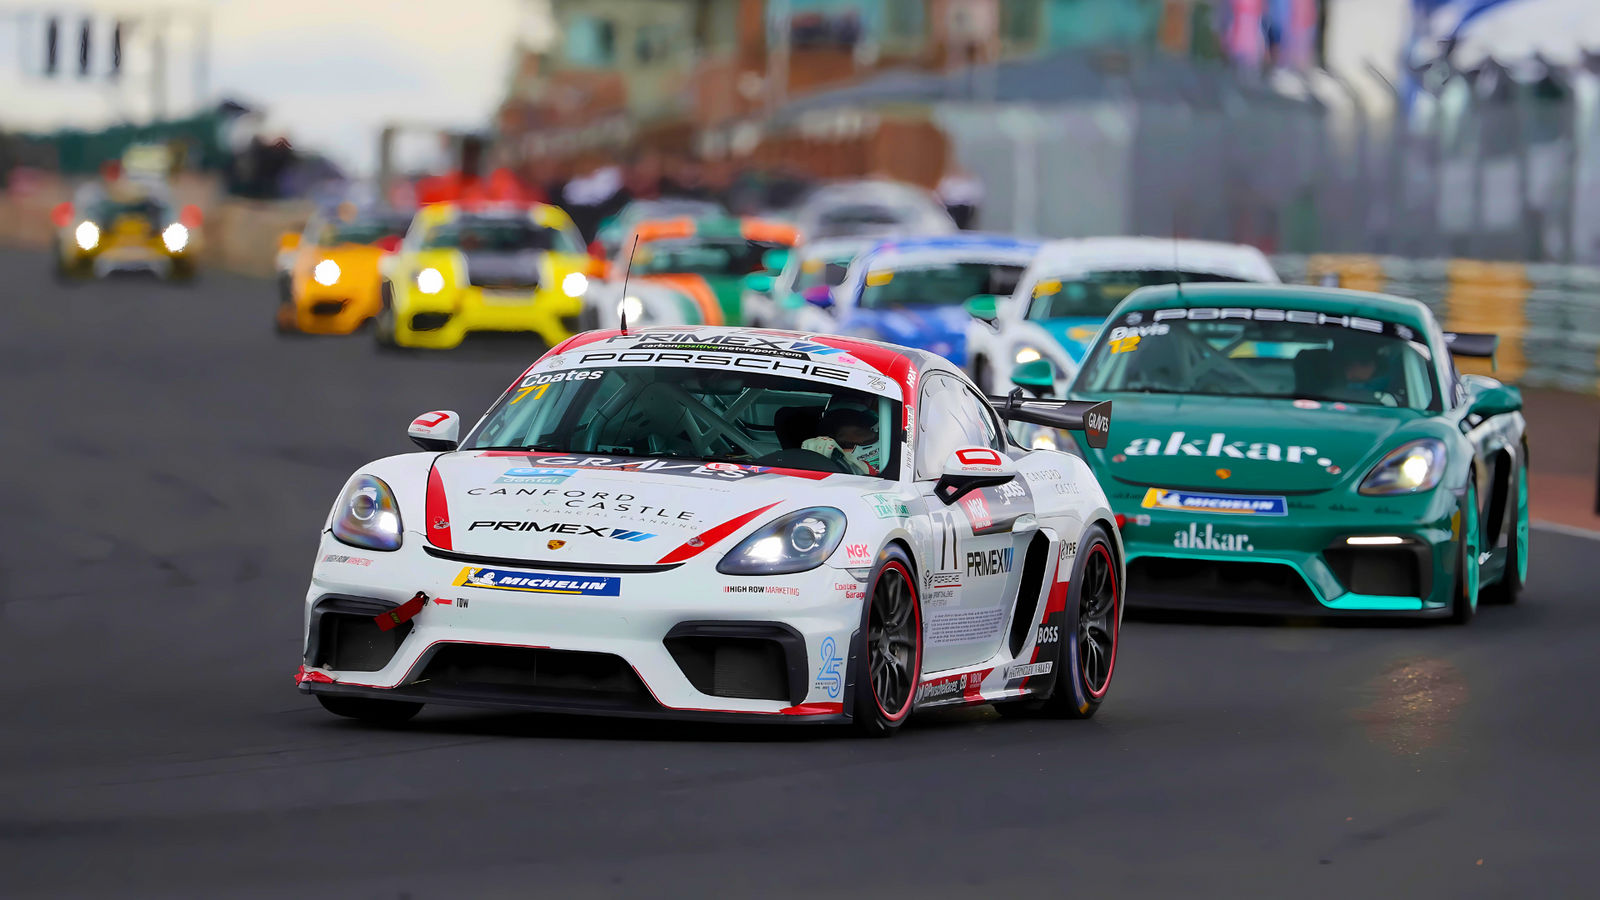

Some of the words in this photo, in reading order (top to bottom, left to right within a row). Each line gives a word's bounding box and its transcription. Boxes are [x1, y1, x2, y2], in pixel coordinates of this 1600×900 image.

[1153, 308, 1382, 333] PORSCHE
[606, 333, 784, 350] PRIMEX
[1109, 323, 1170, 342] Davis
[642, 343, 802, 358] carbonpositivemotorsport.com
[1108, 336, 1141, 354] 12
[579, 353, 850, 382] PORSCHE
[520, 370, 604, 388] Coates
[509, 384, 551, 405] 71
[1088, 412, 1108, 432] GRAVES
[1124, 431, 1332, 466] akkar.
[536, 457, 748, 478] GRAVES
[1026, 469, 1061, 481] CANFORD
[467, 488, 635, 501] CANFORD
[1055, 482, 1080, 495] CASTLE
[565, 500, 703, 523] CASTLE.
[965, 497, 988, 520] NGK
[1183, 497, 1274, 511] MICHELIN
[526, 508, 607, 518] FINANCIAL
[619, 515, 698, 530] PLANNING
[468, 521, 609, 537] PRIMEX
[1173, 522, 1255, 552] akkar.
[932, 511, 958, 571] 71
[845, 544, 871, 558] NGK
[966, 548, 1005, 577] PRIMEX
[498, 577, 607, 590] MICHELIN
[834, 583, 857, 591] Coates
[934, 574, 960, 583] PORSCHE
[729, 585, 747, 593] HIGH
[748, 585, 765, 593] ROW
[765, 586, 800, 597] MARKETING
[456, 597, 470, 609] TOW
[1037, 625, 1059, 644] BOSS
[816, 636, 843, 699] 25
